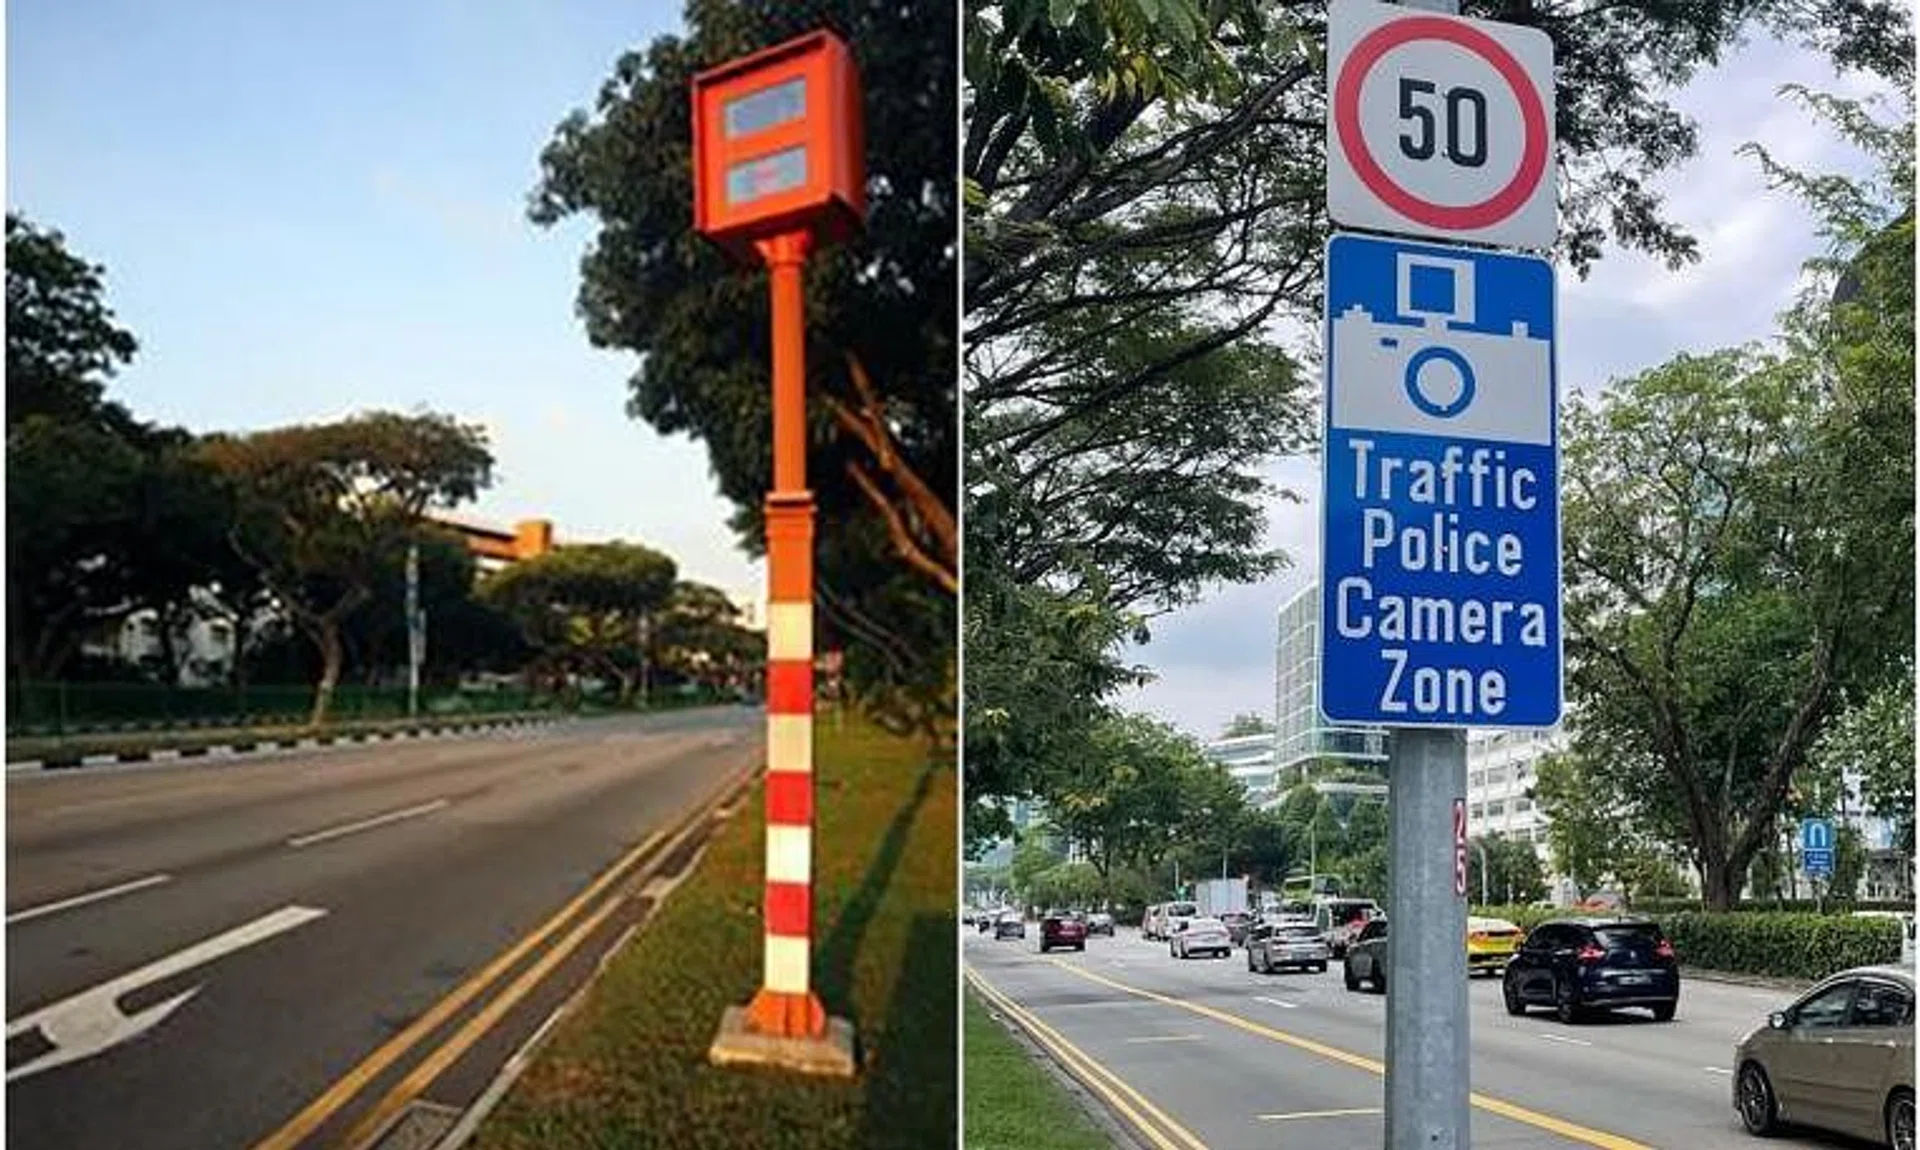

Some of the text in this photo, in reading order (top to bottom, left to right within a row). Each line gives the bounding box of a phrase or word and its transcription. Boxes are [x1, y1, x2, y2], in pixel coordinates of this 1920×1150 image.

[1399, 77, 1488, 168] 50
[1348, 438, 1537, 510] Traffic
[1362, 508, 1523, 576] Police
[1336, 576, 1547, 647] Camera
[1380, 649, 1507, 714] Zone
